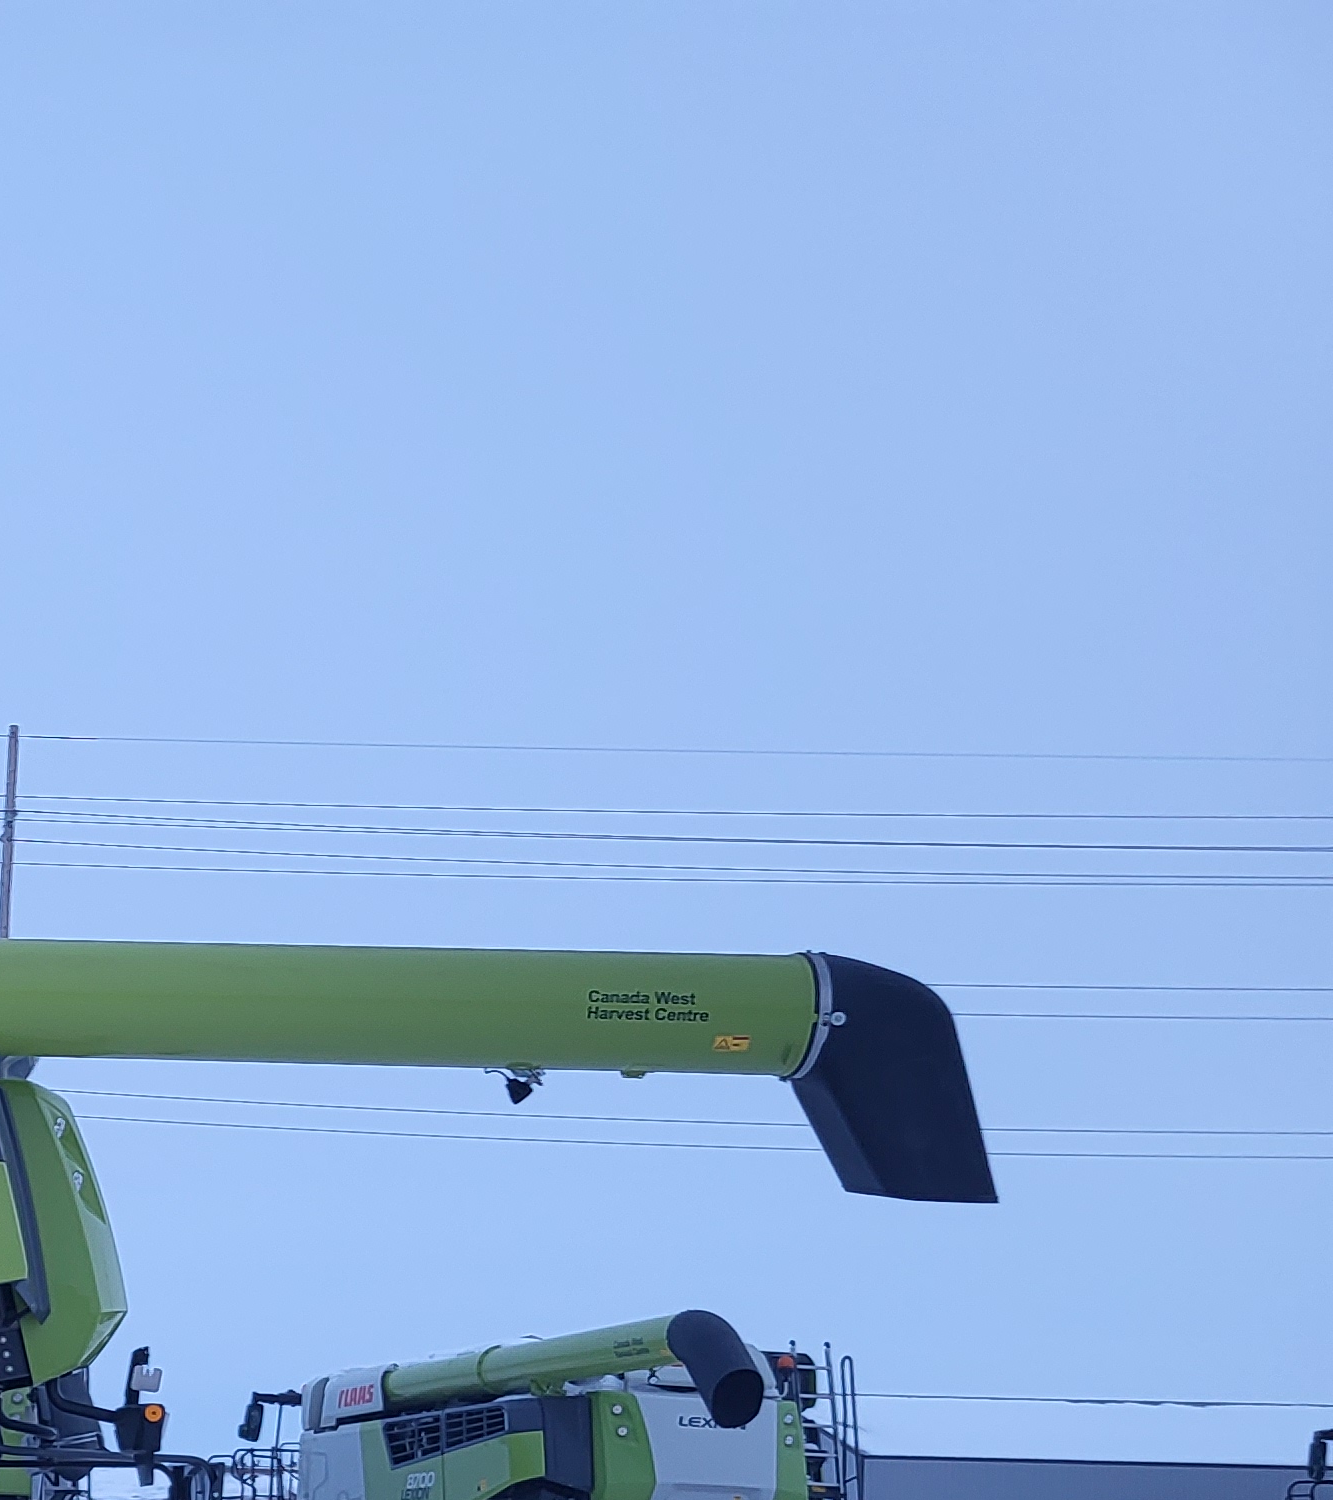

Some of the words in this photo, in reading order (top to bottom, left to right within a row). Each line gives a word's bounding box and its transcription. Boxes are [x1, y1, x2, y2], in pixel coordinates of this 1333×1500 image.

[588, 990, 650, 1005] Canada
[655, 991, 696, 1006] West
[587, 1006, 650, 1022] Harvest
[655, 1007, 709, 1023] Centre
[406, 1471, 436, 1489] 8700
